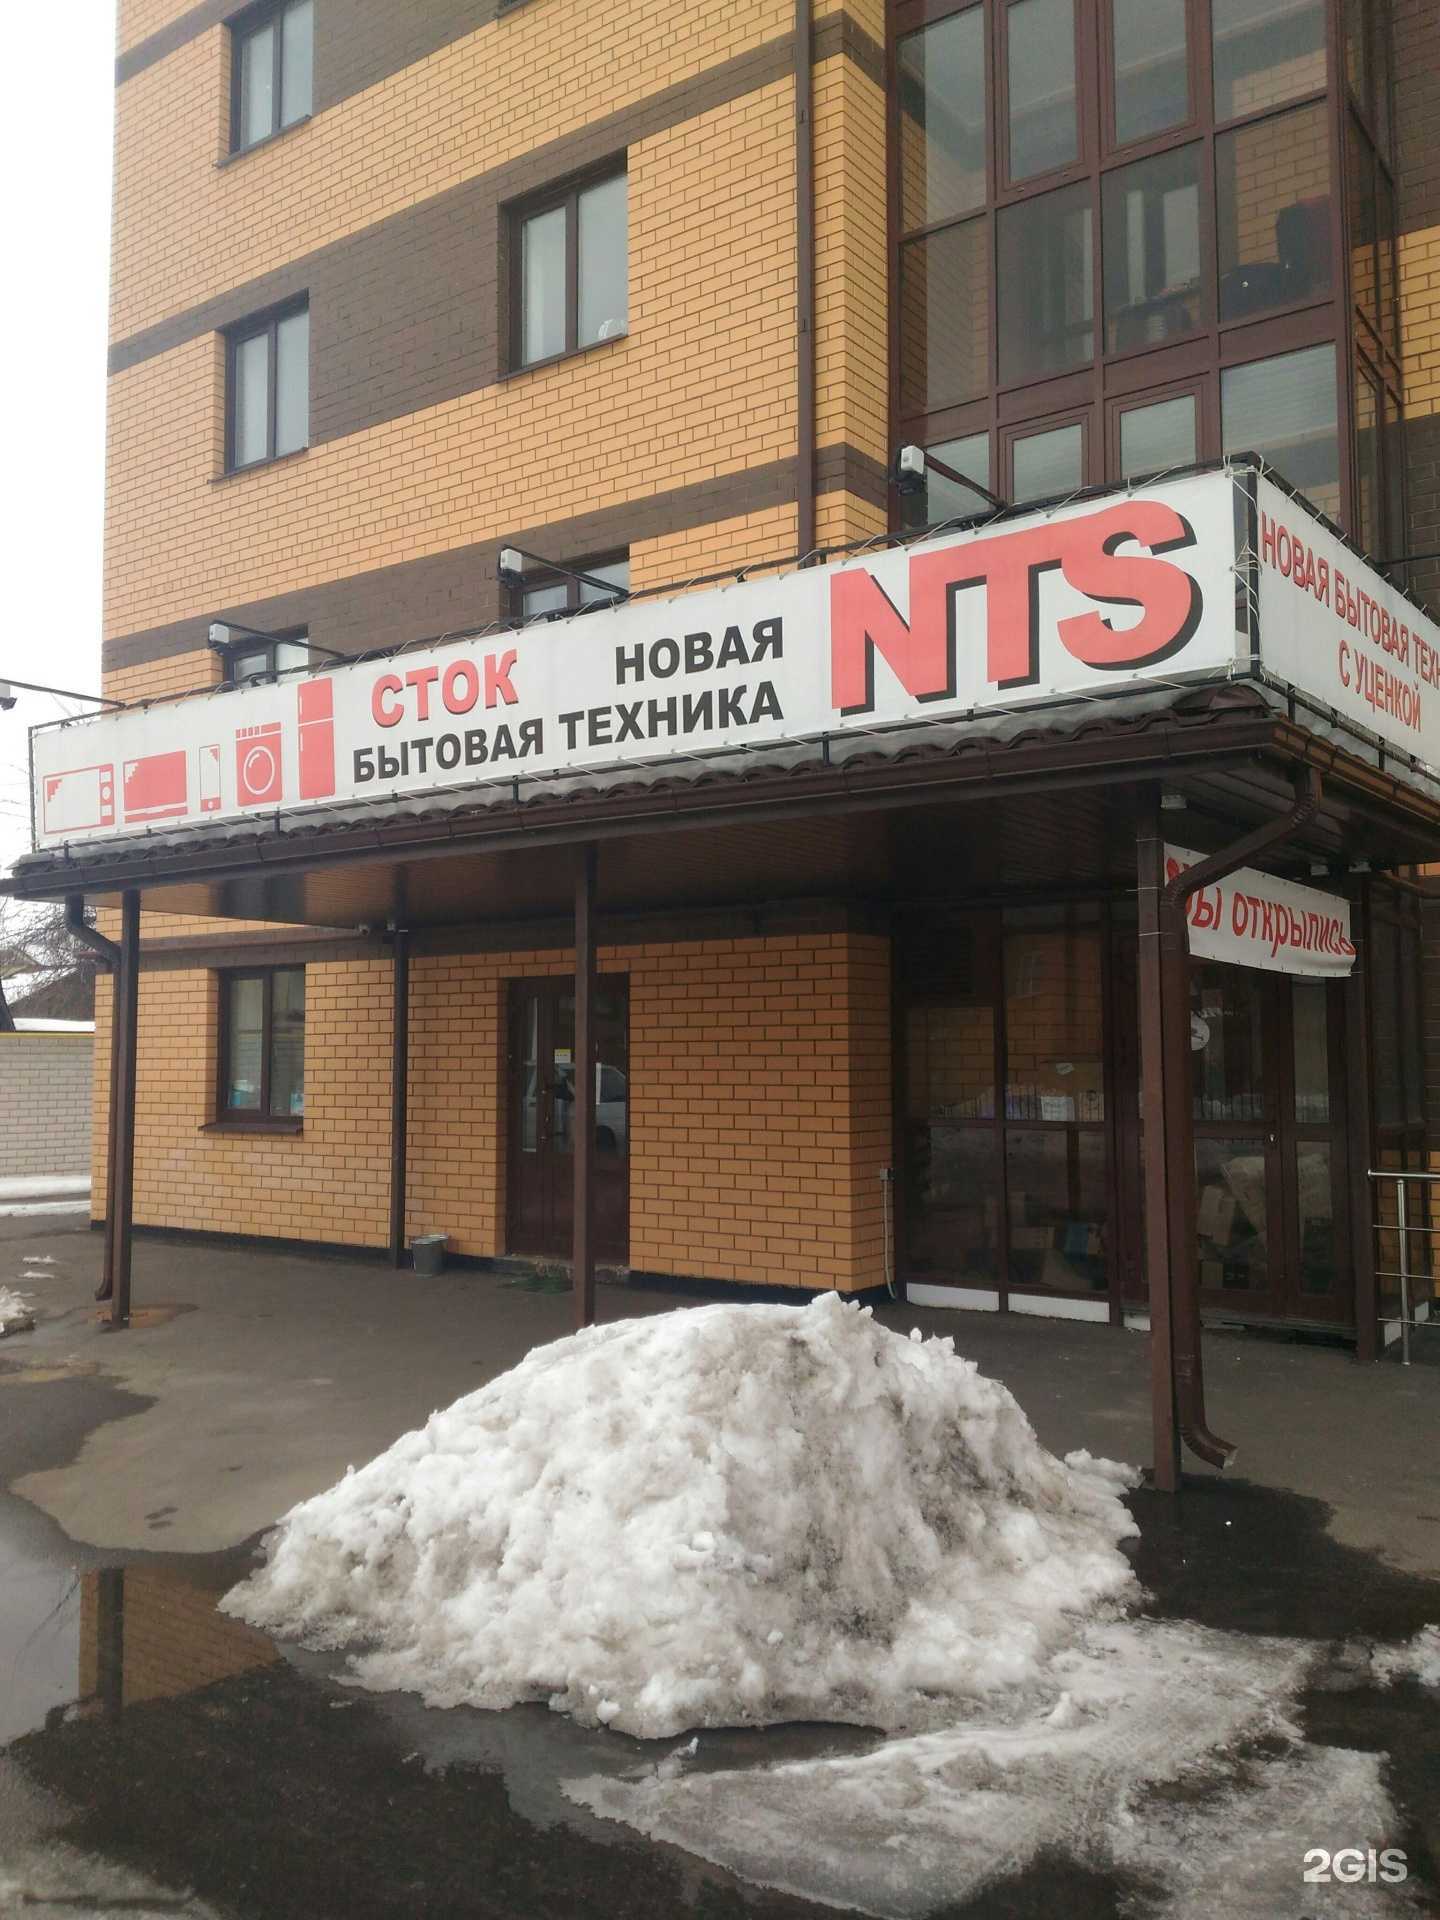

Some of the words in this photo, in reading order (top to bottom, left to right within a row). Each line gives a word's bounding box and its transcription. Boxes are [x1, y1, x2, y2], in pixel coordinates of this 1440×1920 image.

[831, 500, 1203, 716] NTS
[1261, 511, 1330, 608] НОВАЯ
[1334, 568, 1409, 667] БЫТОВАЯ
[371, 648, 519, 729] СТОК
[615, 616, 783, 686] НОВАЯ
[1339, 639, 1350, 688] С
[1354, 648, 1421, 733] УЦЕНКОЙ
[353, 718, 544, 784] БЫТОВАЯ
[558, 680, 784, 751] ТЕХНИКА
